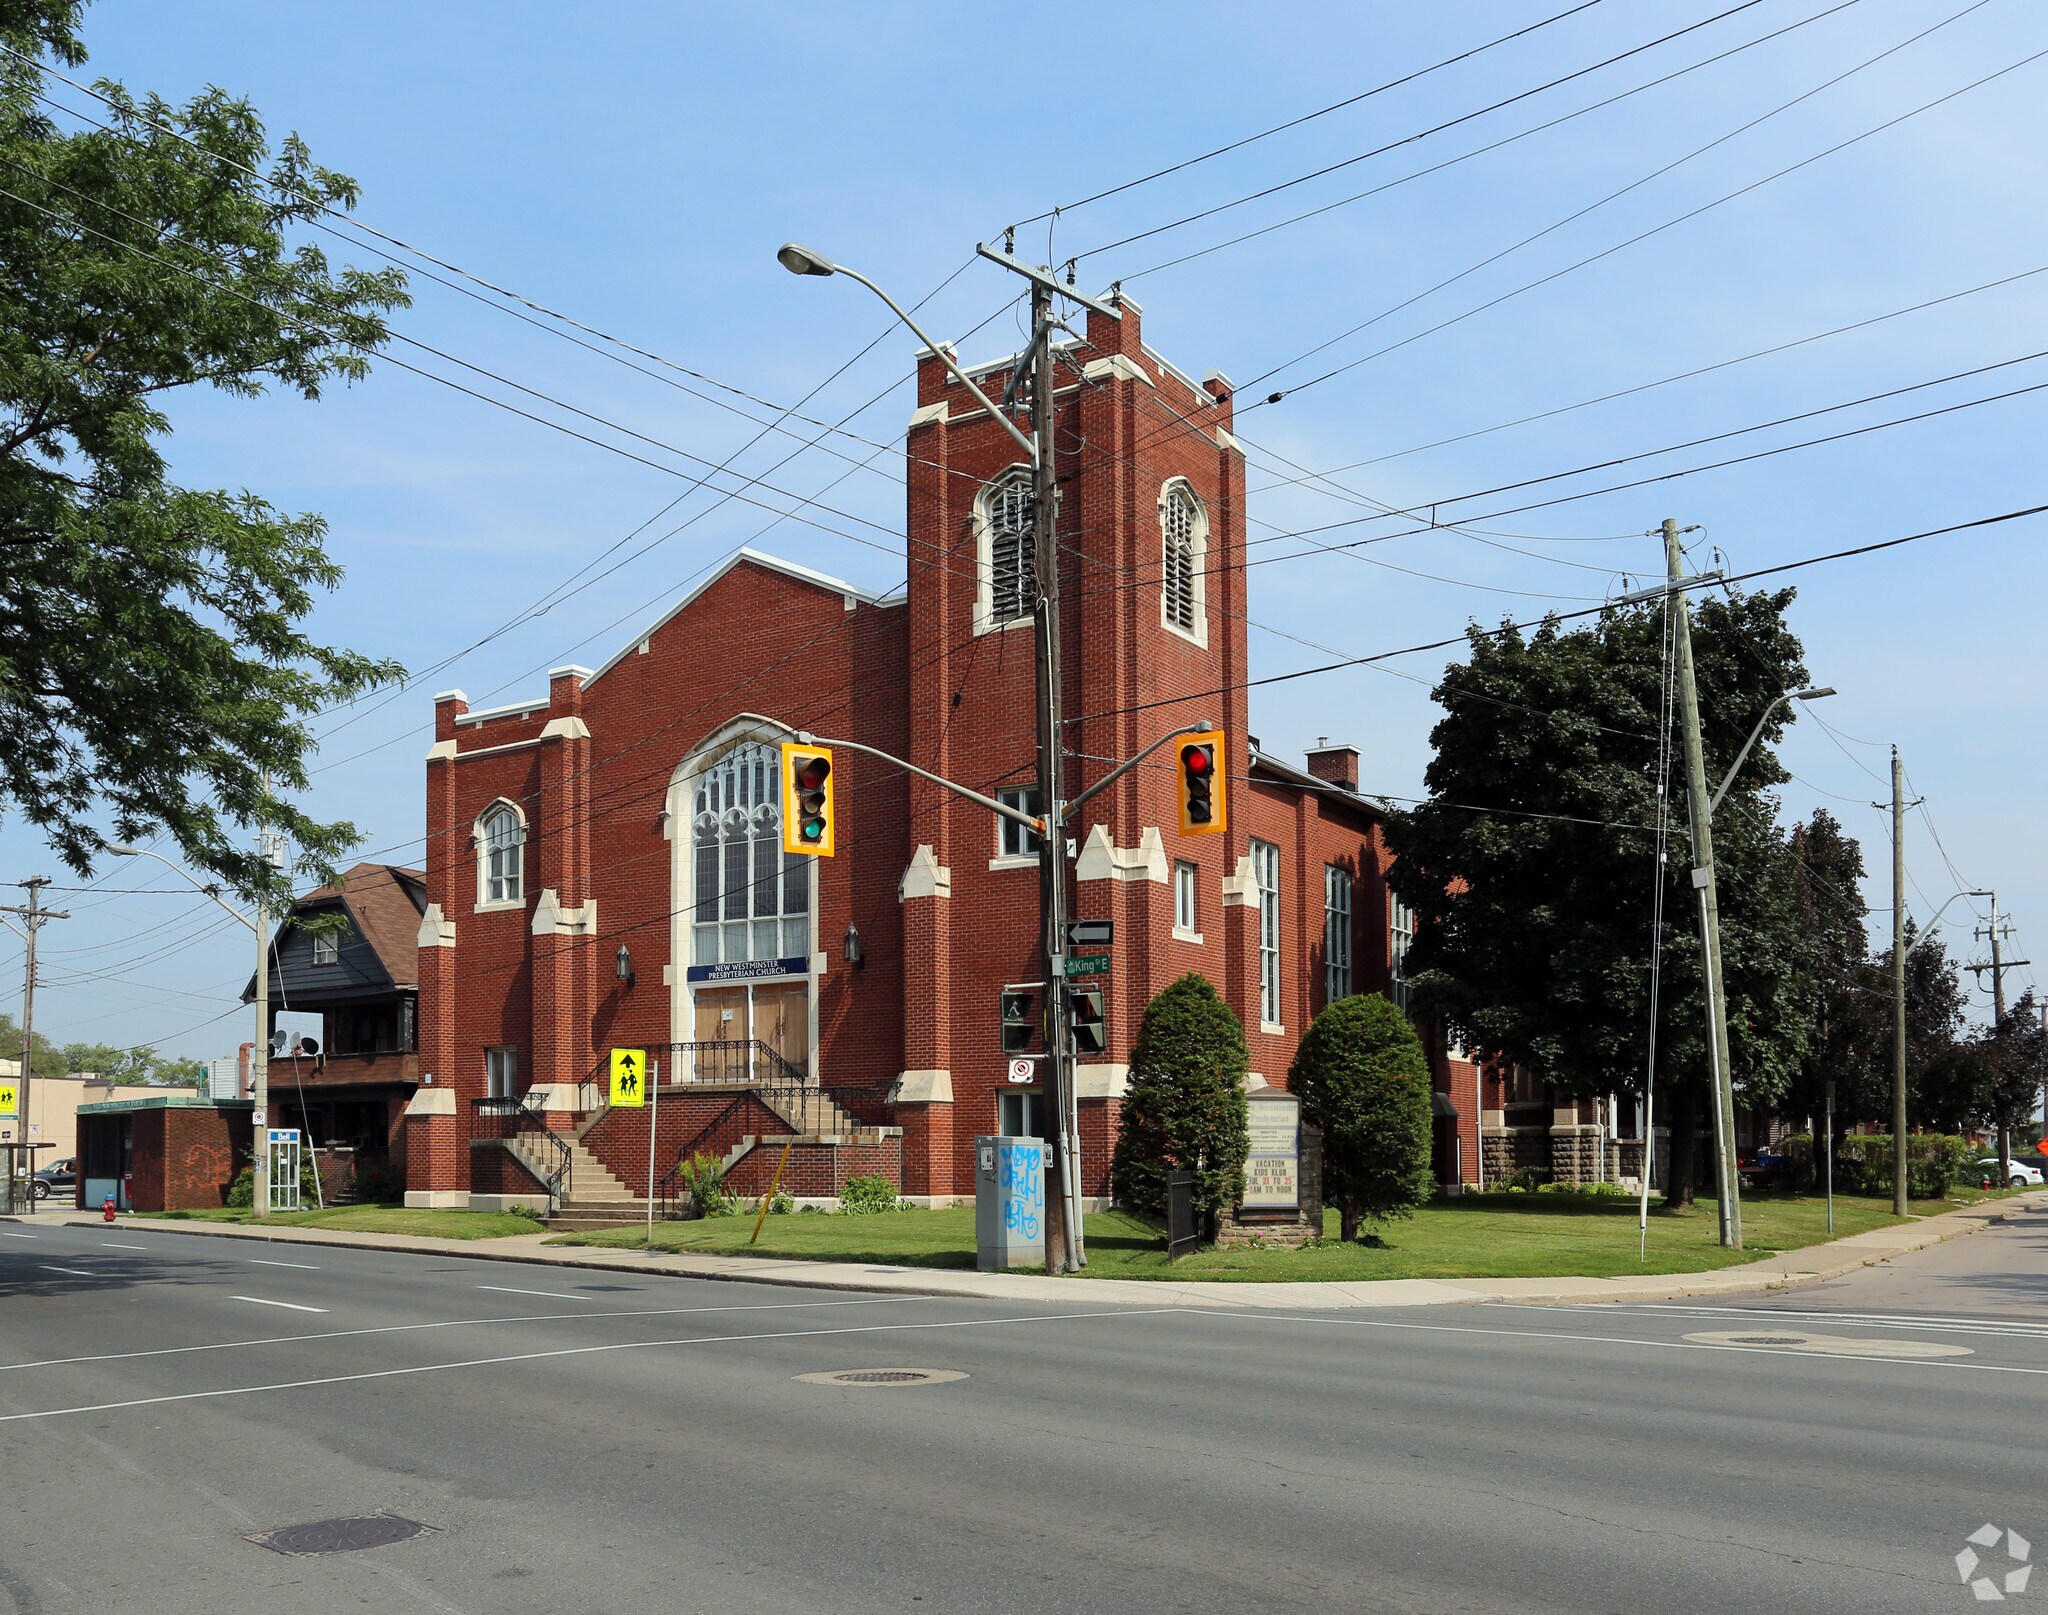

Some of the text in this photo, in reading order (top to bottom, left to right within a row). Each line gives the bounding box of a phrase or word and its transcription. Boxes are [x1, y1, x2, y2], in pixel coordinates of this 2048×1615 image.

[715, 960, 779, 972] NEW WESTMINSTER
[1075, 960, 1095, 973] King
[1102, 958, 1108, 970] E
[708, 967, 786, 979] PRESBYTERIAN CHURCH
[278, 1132, 290, 1141] Bell
[1256, 1160, 1285, 1168] VACATION
[1254, 1168, 1287, 1176] KIDS KLUB
[1248, 1176, 1292, 1185] JUL 21 TO 25
[1248, 1185, 1292, 1194] 9AM TO NOON
